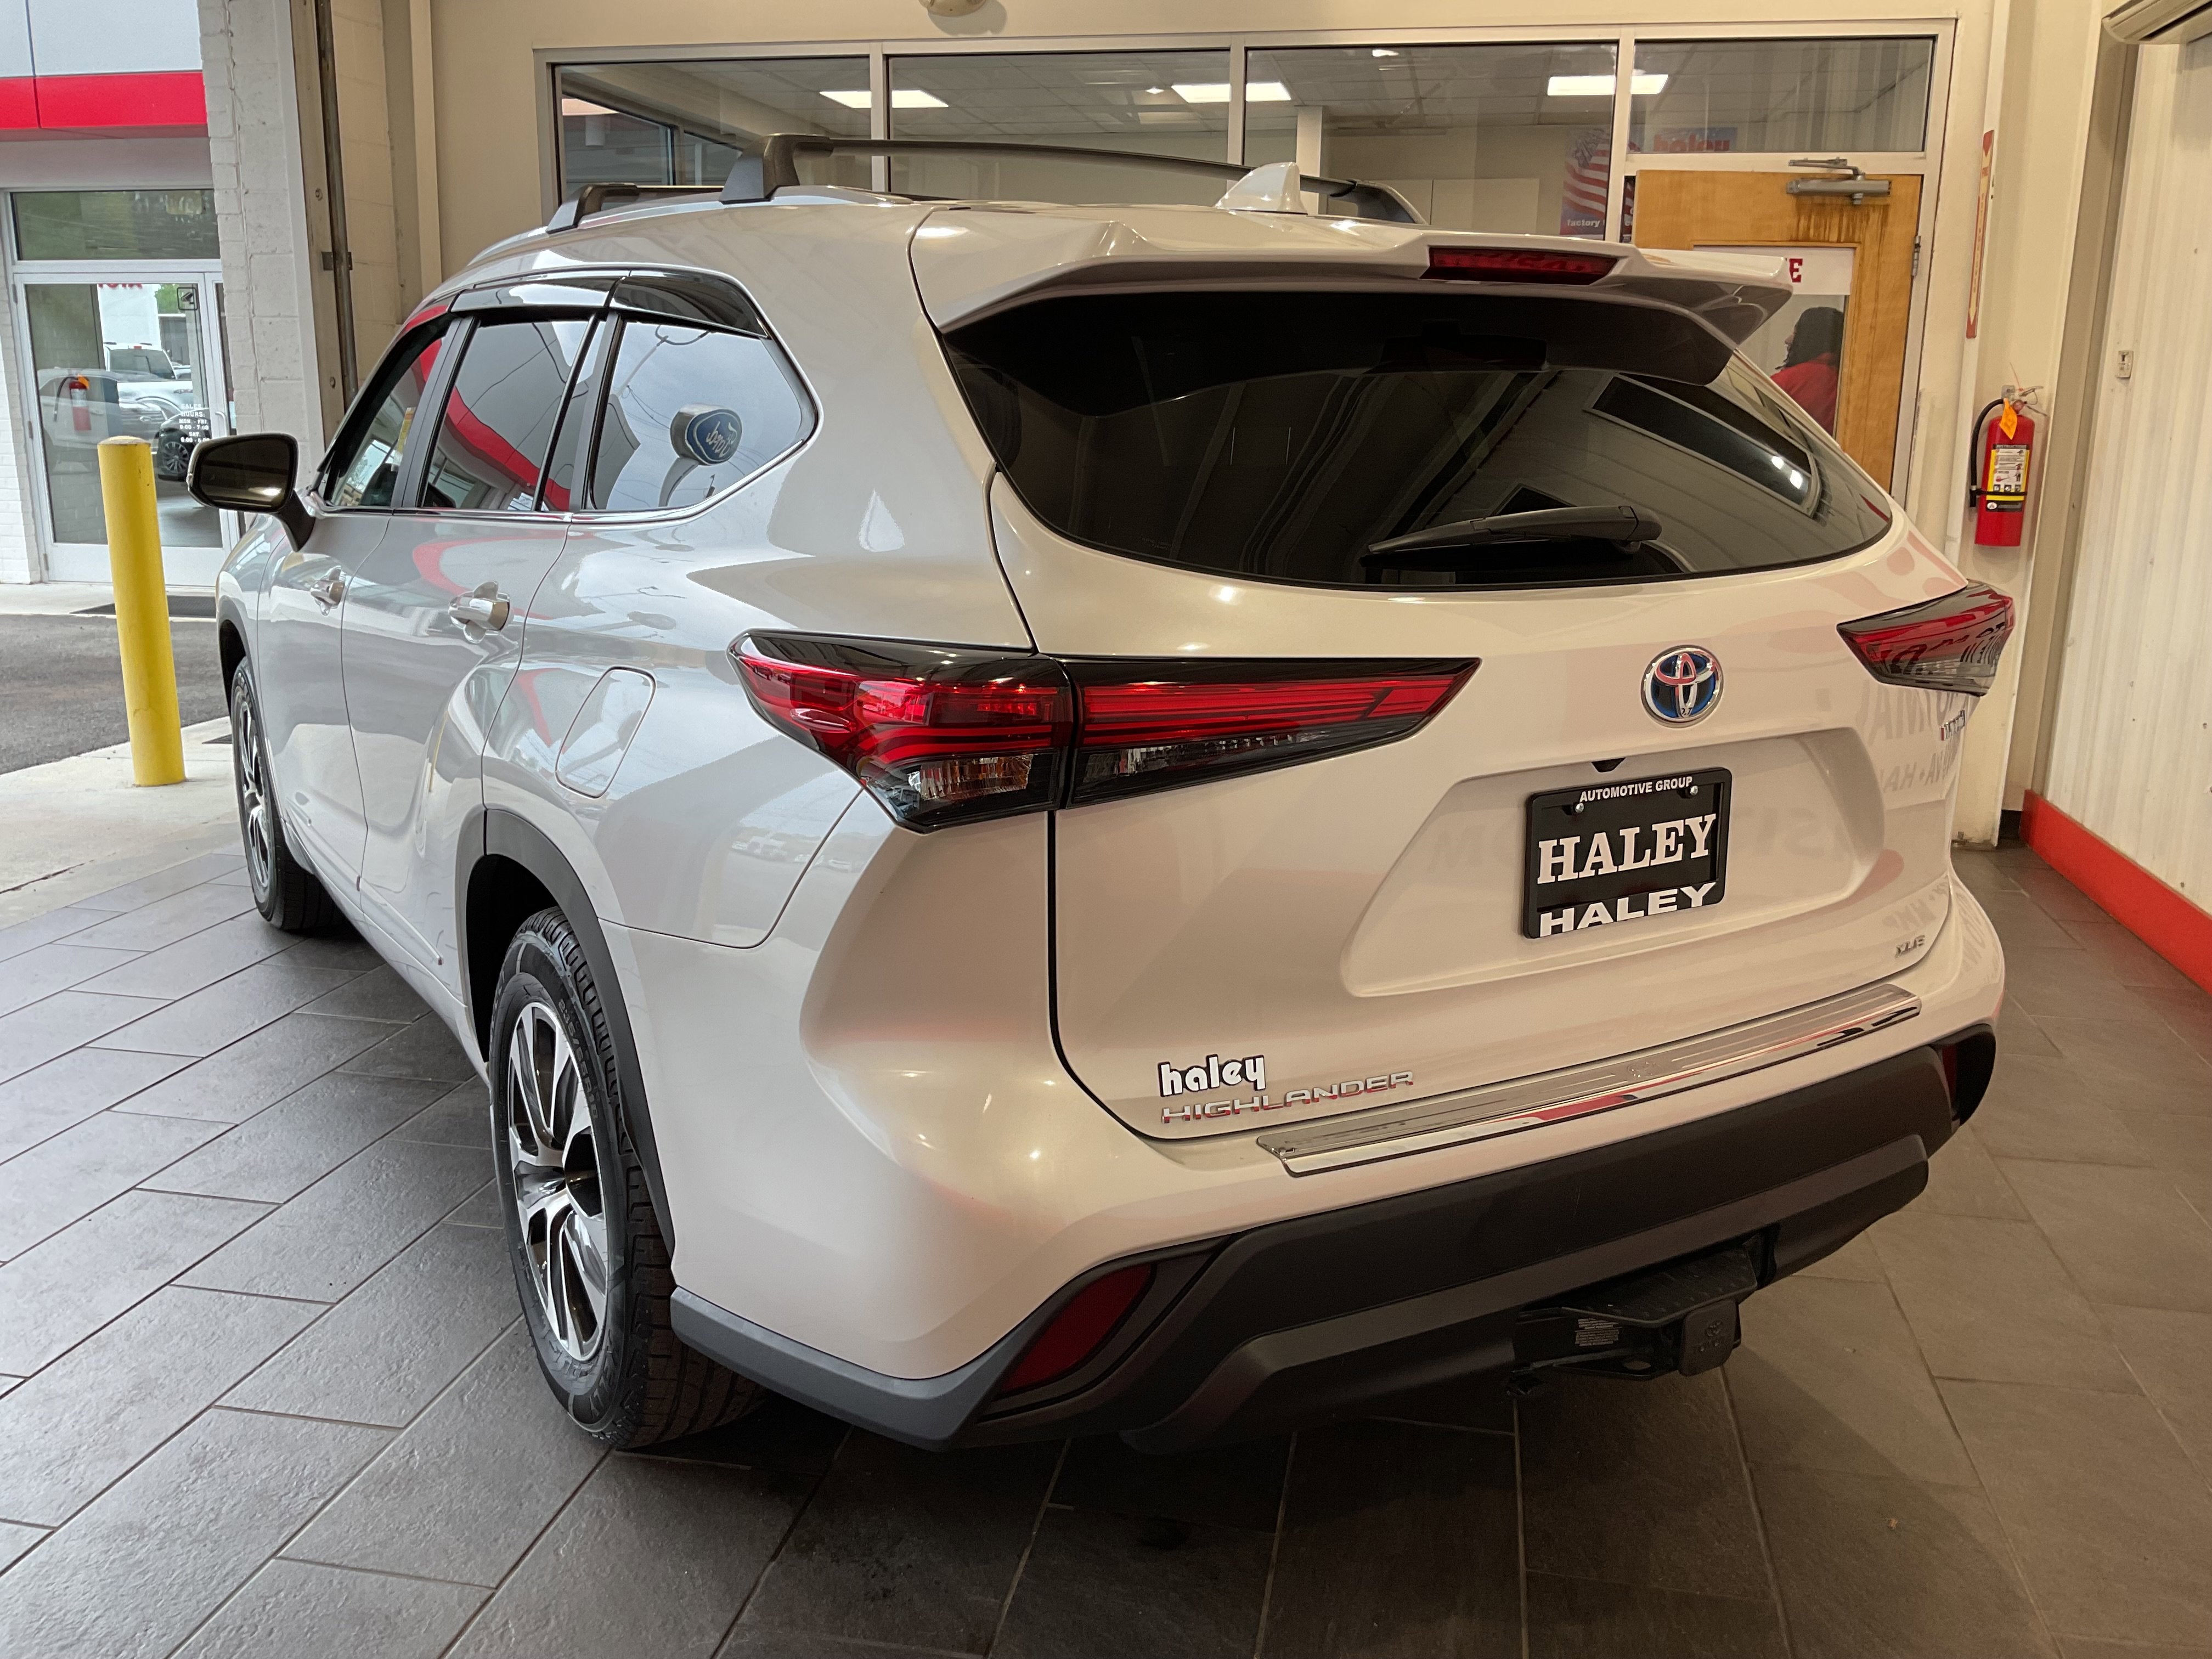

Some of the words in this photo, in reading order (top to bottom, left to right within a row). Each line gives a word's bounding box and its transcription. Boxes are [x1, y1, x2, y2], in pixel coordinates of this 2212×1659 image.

[1579, 782, 1652, 803] AUTOMOTIVE
[1655, 776, 1694, 792] GROUP
[1537, 813, 1717, 884] HALEY
[1539, 882, 1717, 938] HALEY
[1158, 1053, 1266, 1097] haley
[1161, 1070, 1414, 1124] HIGHLANDER
